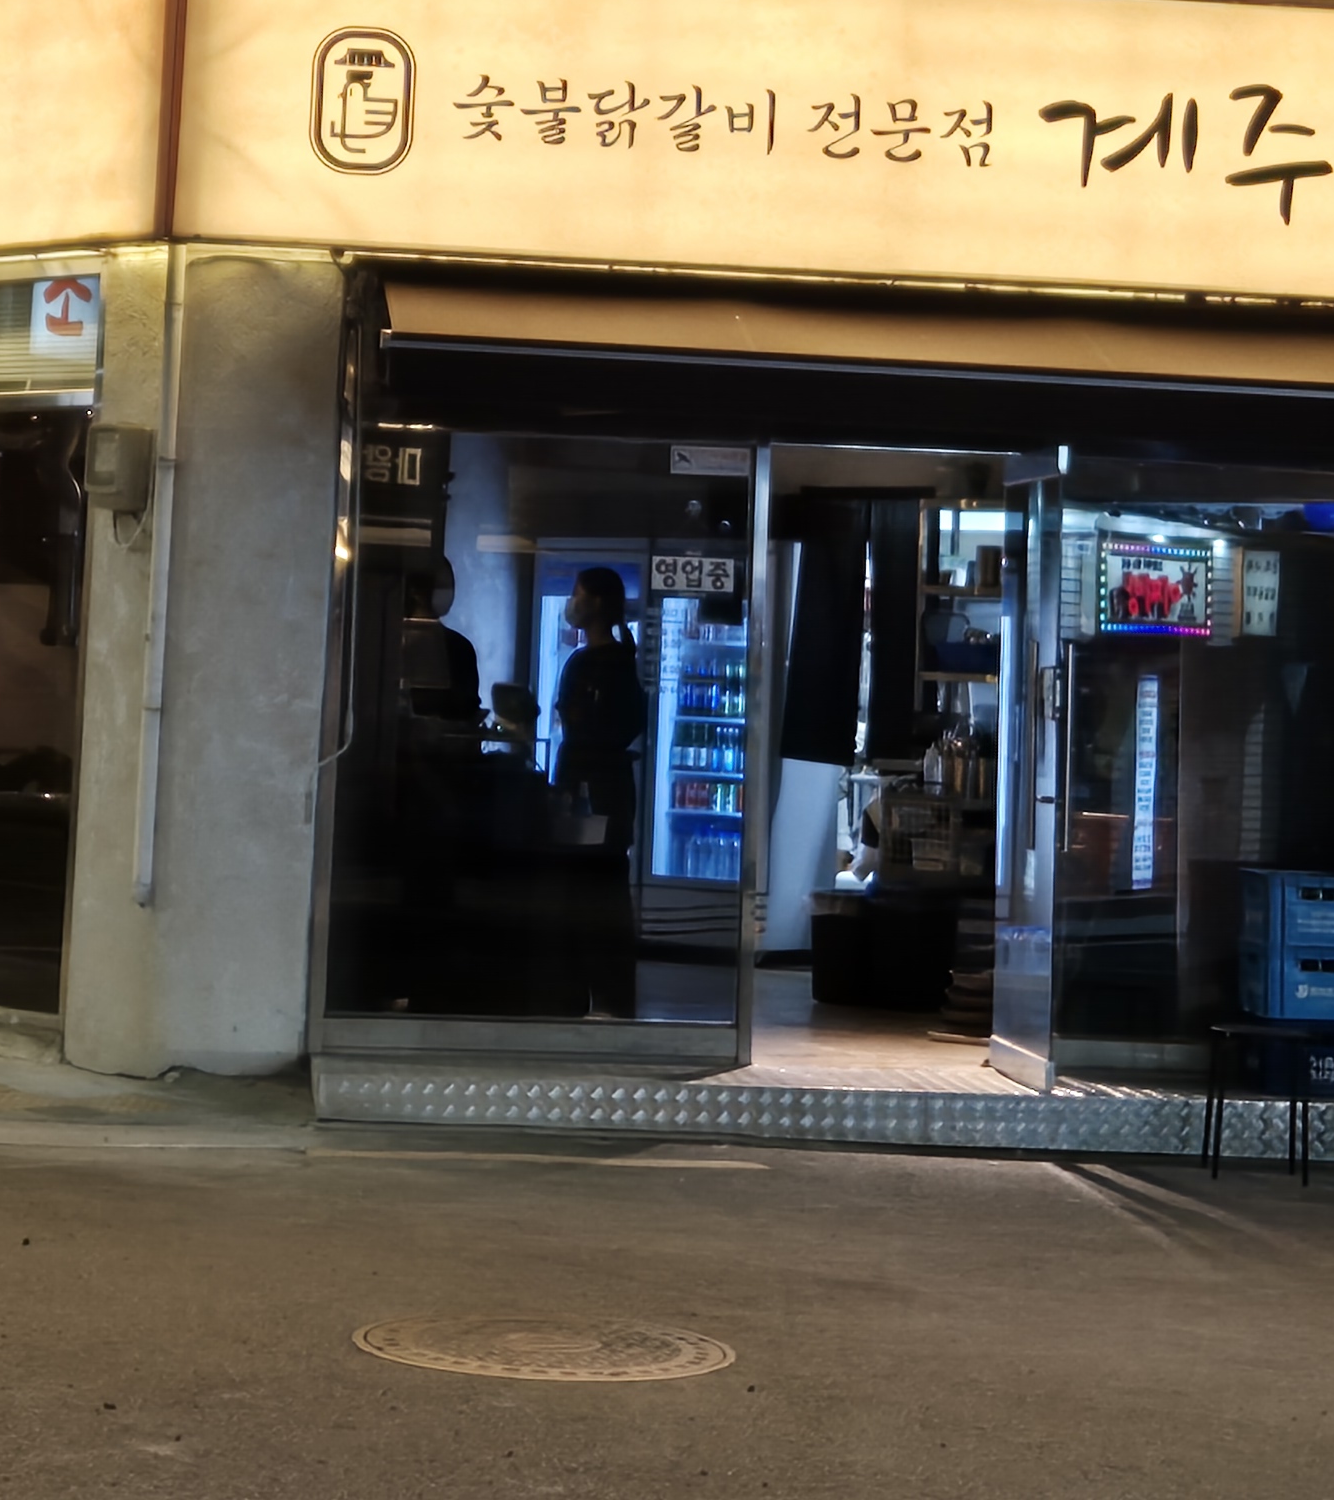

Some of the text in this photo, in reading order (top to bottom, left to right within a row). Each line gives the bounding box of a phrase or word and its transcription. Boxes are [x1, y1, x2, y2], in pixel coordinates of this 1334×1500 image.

[453, 73, 777, 156] 숯불닭갈비
[807, 93, 994, 168] 전문점
[654, 558, 731, 591] 영업중
